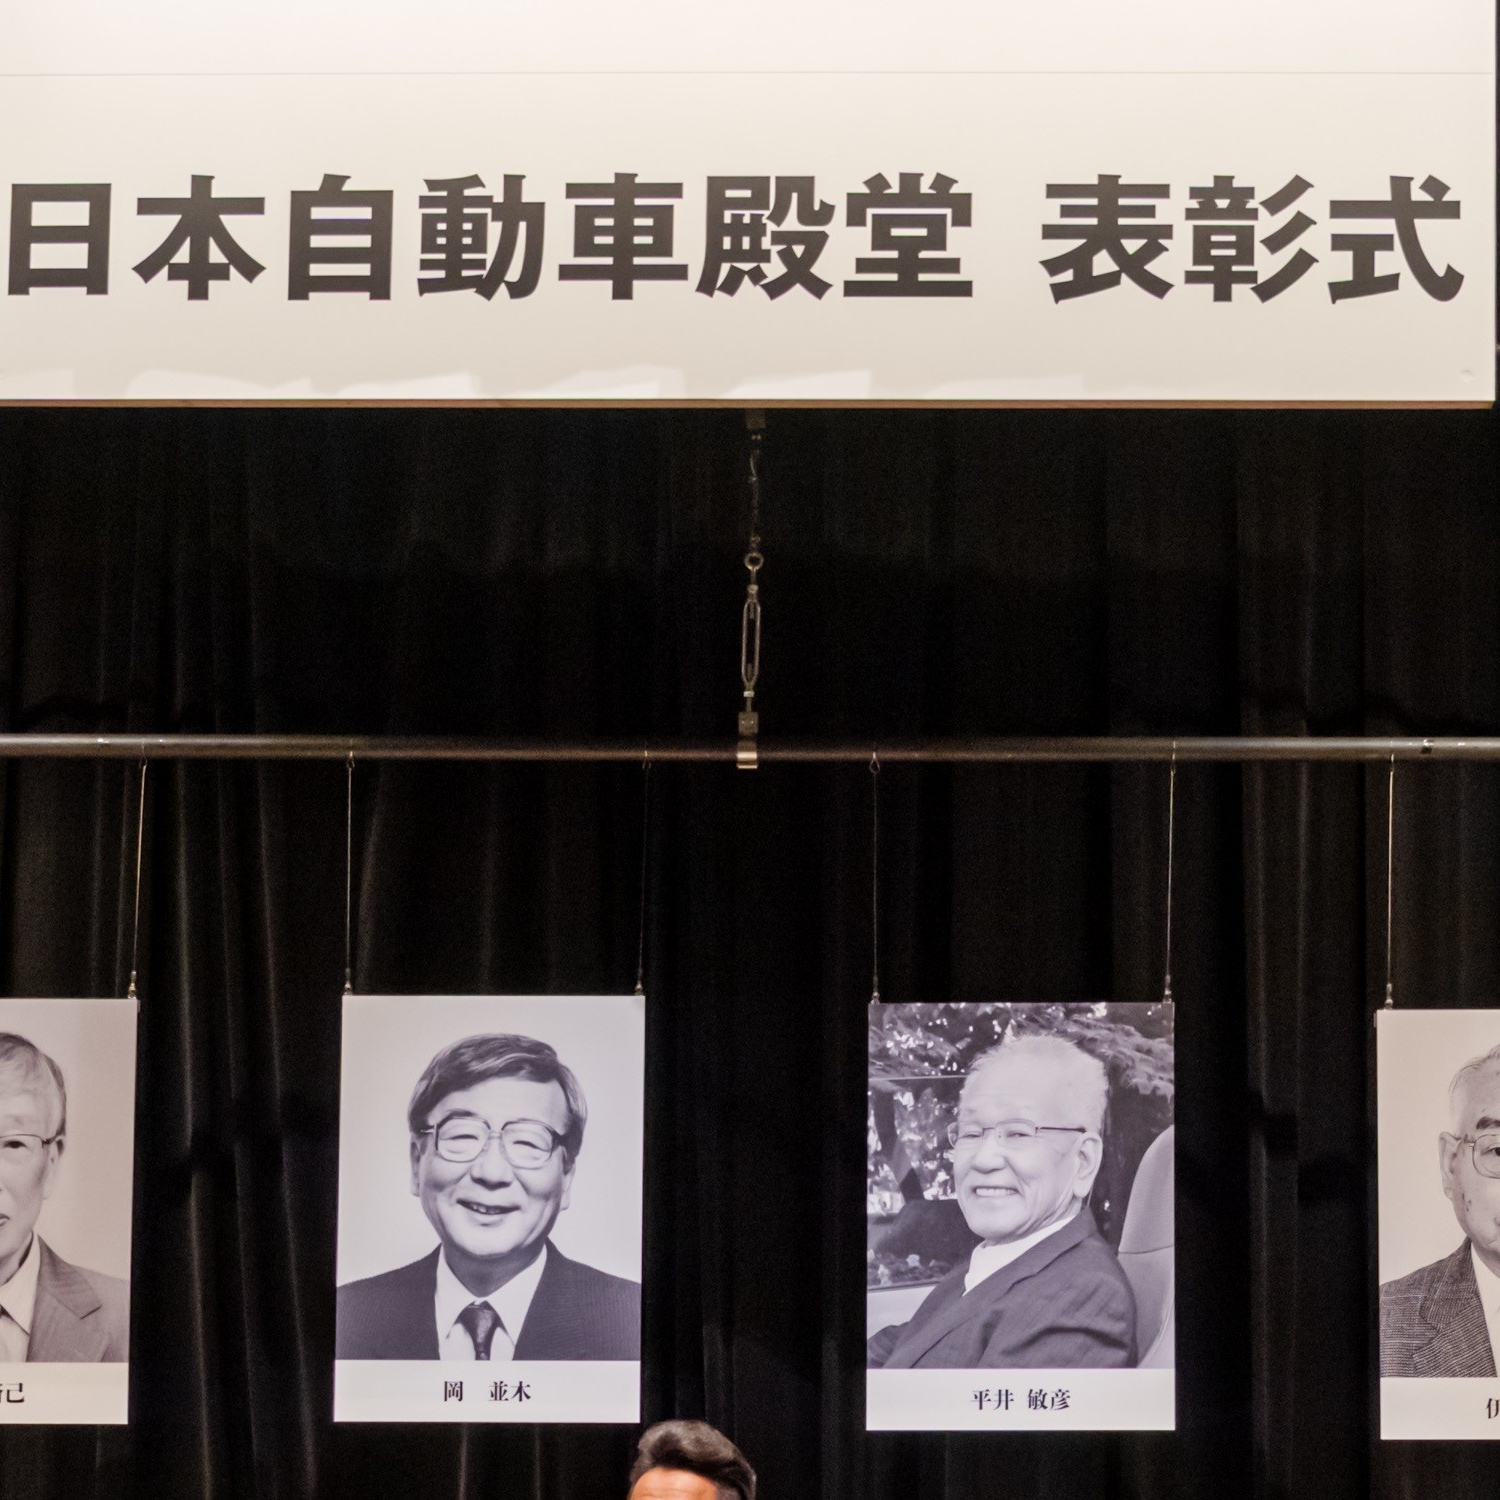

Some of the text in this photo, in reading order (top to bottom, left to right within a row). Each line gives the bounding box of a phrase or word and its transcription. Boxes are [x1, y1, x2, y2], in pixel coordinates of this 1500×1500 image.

[5, 172, 1466, 305] 日本自動車殿堂 表彰式
[443, 1380, 531, 1402] 岡 並木
[971, 1389, 1071, 1410] 平井 敏彦
